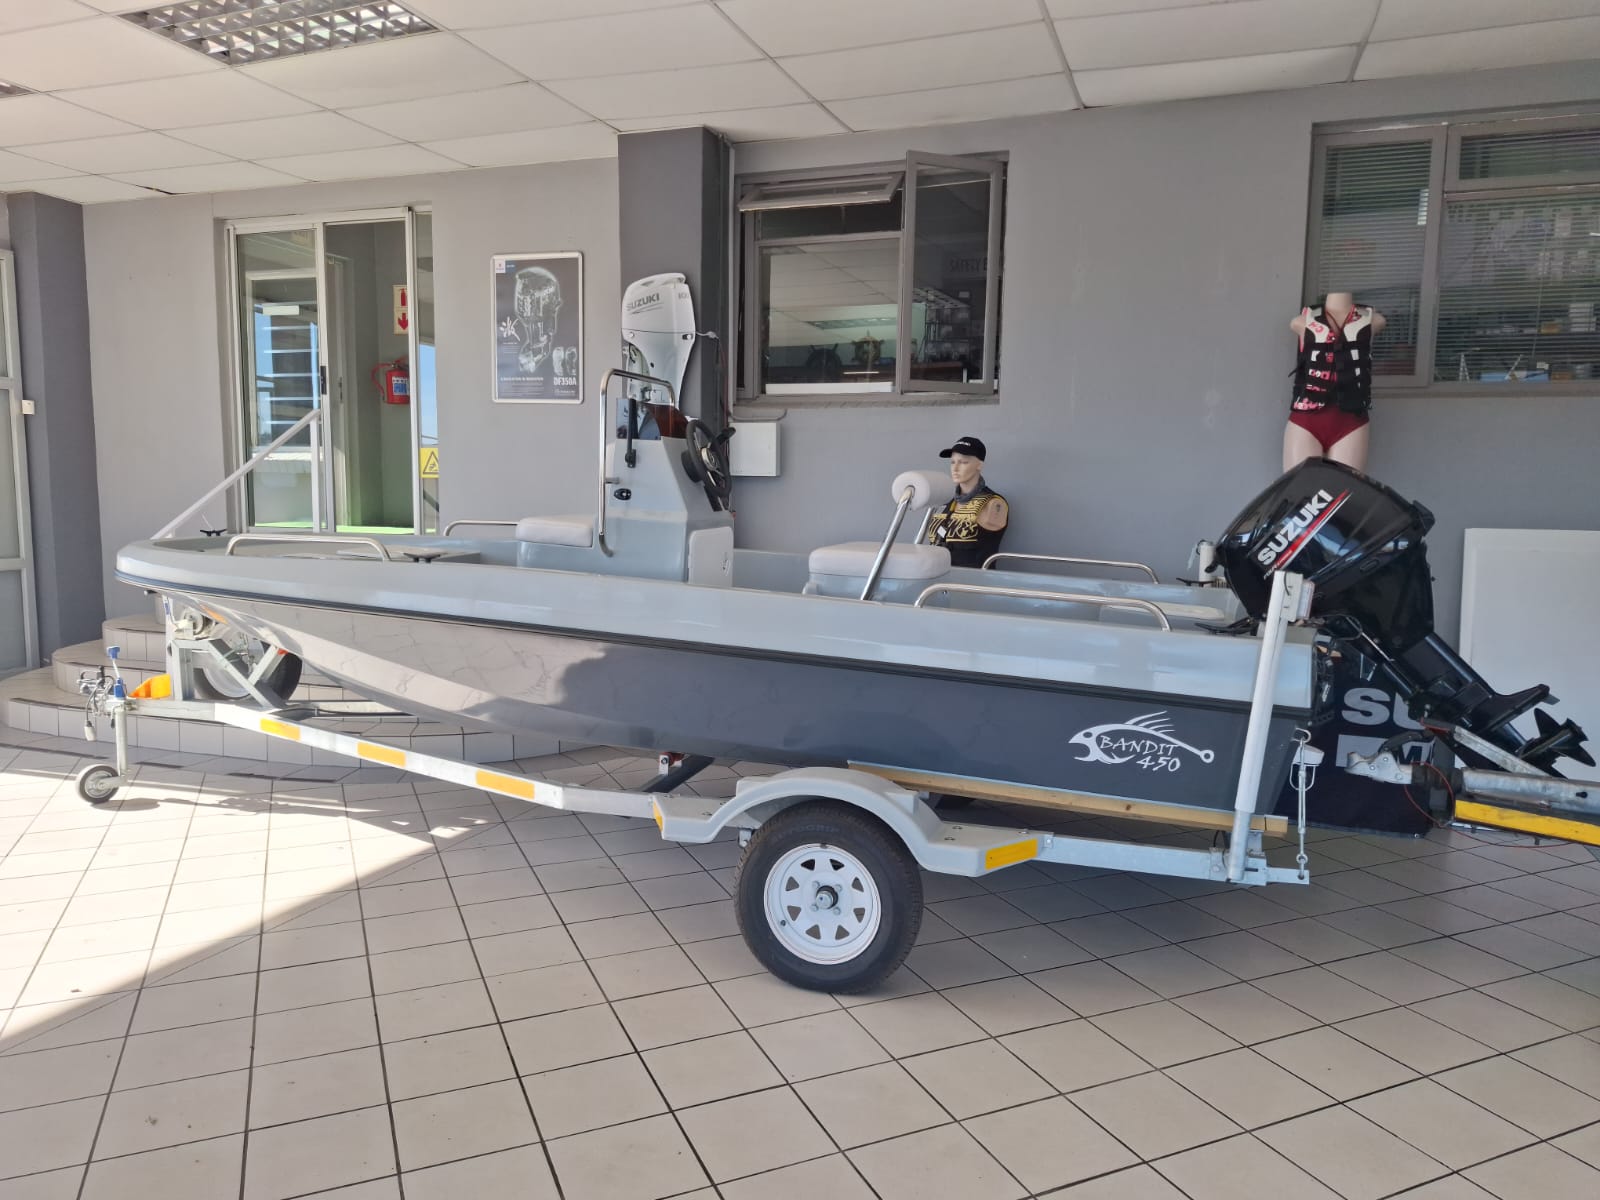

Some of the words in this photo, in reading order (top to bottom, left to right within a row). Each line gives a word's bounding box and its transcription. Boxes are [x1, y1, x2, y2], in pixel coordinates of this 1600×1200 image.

[626, 293, 660, 311] SUZUKI
[553, 376, 577, 386] DF350A
[1257, 489, 1334, 566] SUZUKI
[1099, 735, 1179, 756] BANDIT
[1135, 755, 1181, 772] 450
